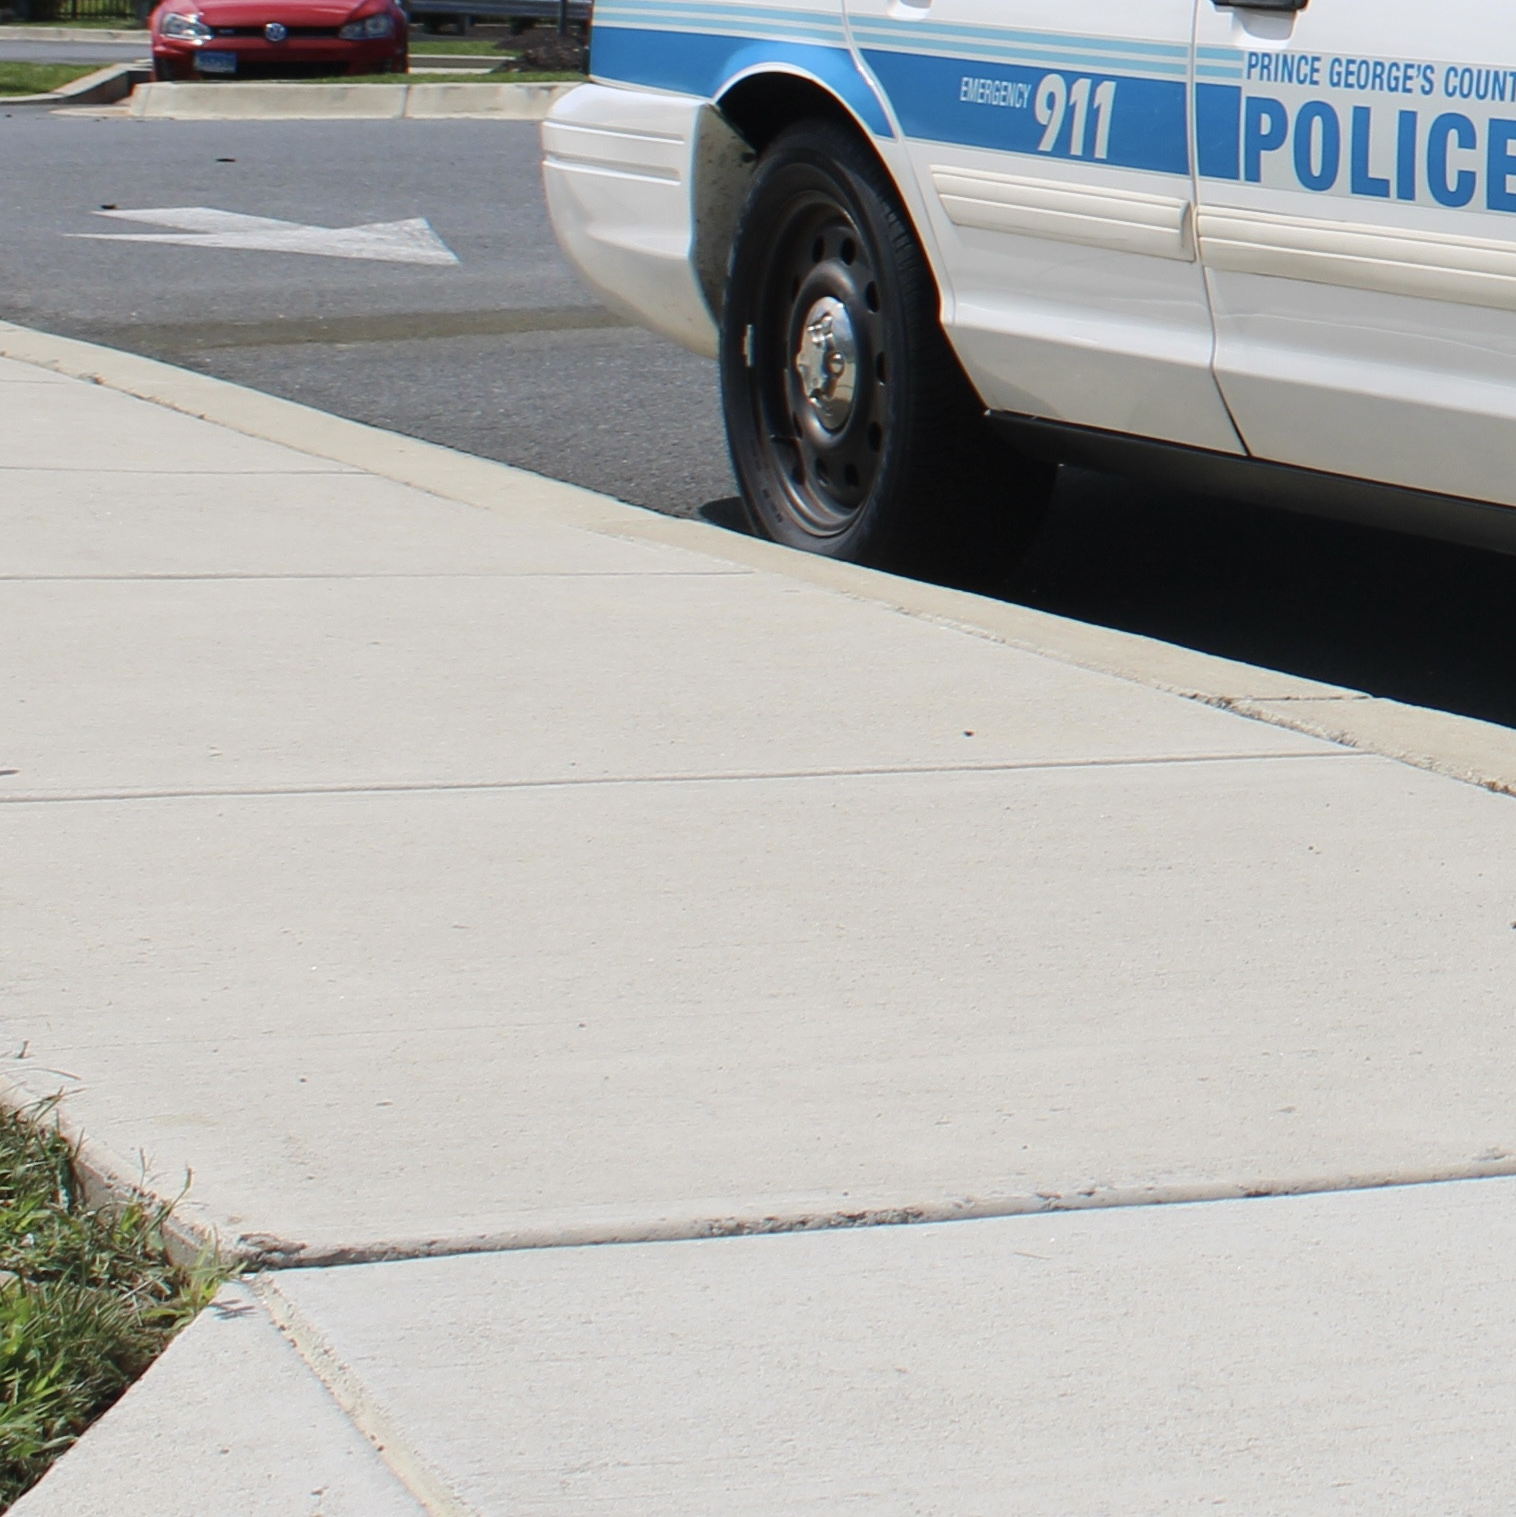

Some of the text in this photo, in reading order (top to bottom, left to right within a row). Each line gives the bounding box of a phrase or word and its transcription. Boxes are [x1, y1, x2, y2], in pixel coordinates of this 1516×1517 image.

[1246, 51, 1322, 86] PRINCE
[1328, 56, 1435, 96] GEORGE'S
[959, 73, 1117, 160] EMERGENCY 911
